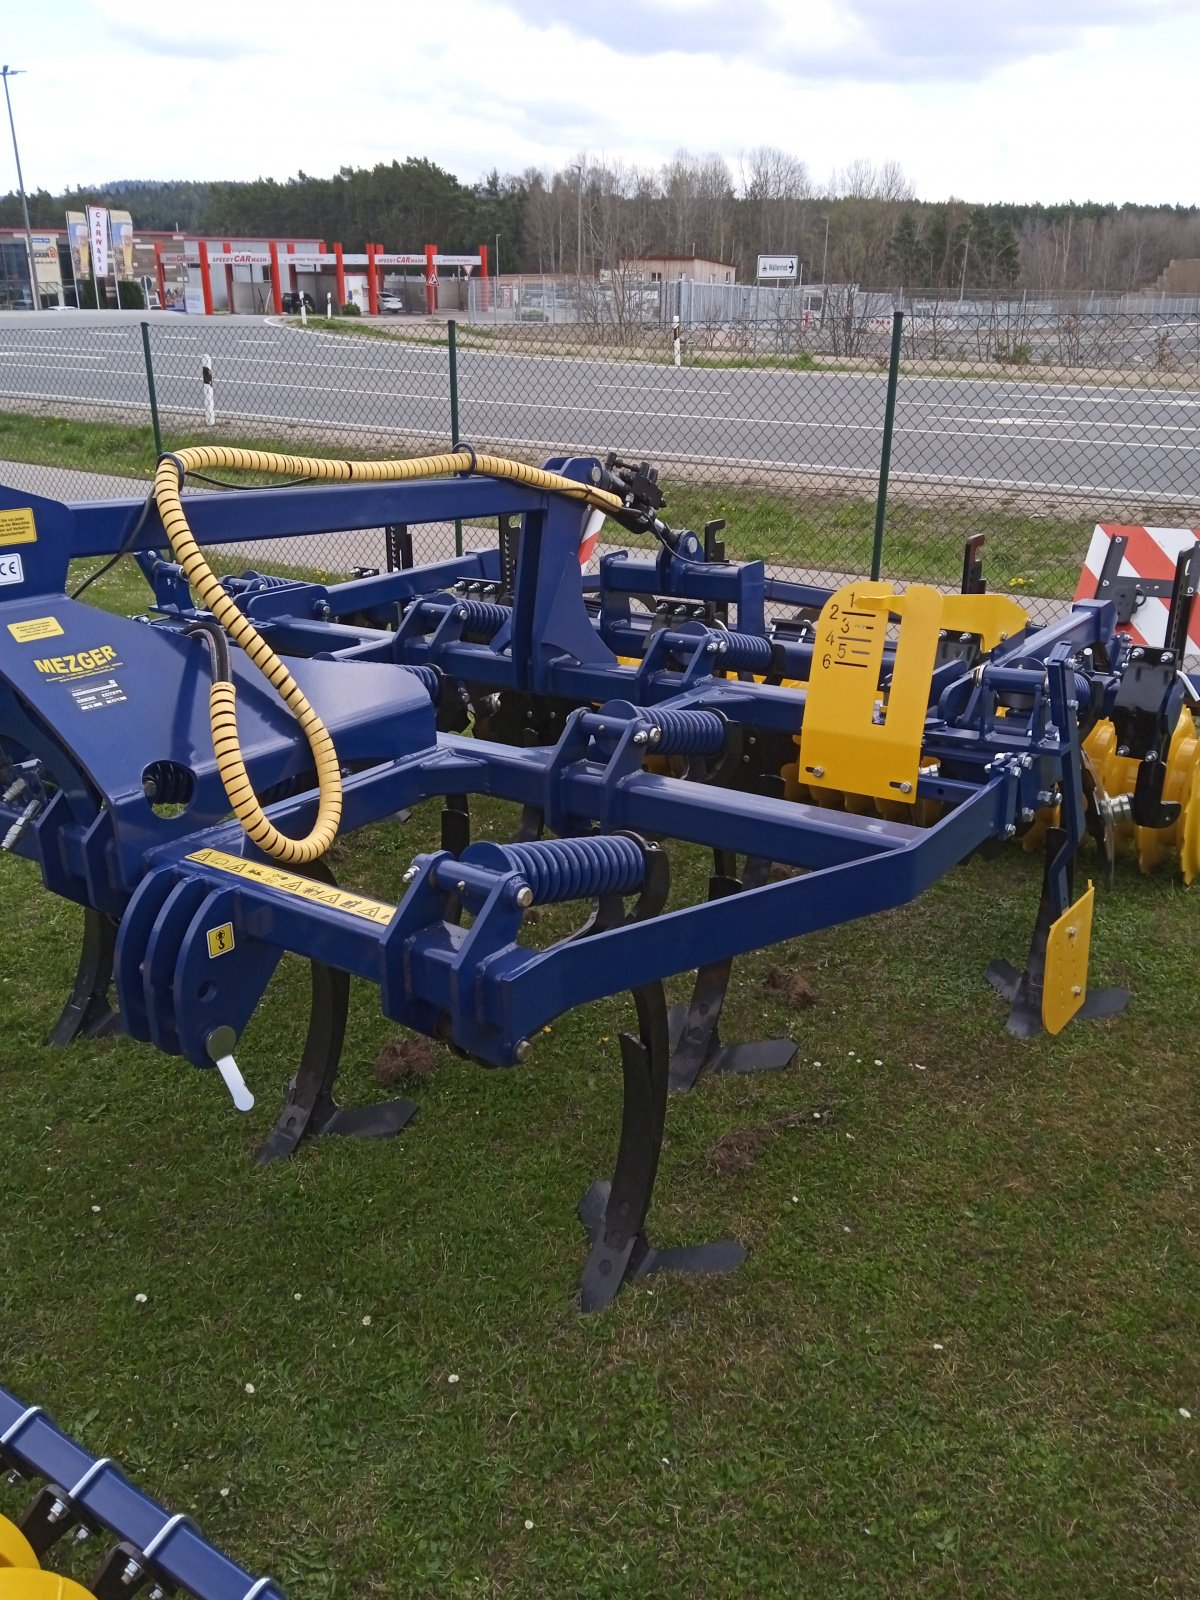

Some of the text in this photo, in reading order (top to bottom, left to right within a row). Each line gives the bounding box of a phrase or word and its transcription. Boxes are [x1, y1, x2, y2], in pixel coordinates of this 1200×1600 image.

[234, 255, 251, 263] CAR
[396, 256, 411, 264] CAR
[0, 561, 17, 576] CE
[849, 592, 855, 608] 1
[829, 604, 839, 620] 2
[840, 617, 850, 634] 3
[825, 630, 835, 646] 4
[837, 643, 847, 659] 5
[33, 645, 117, 674] MEZGER
[822, 653, 832, 669] 6
